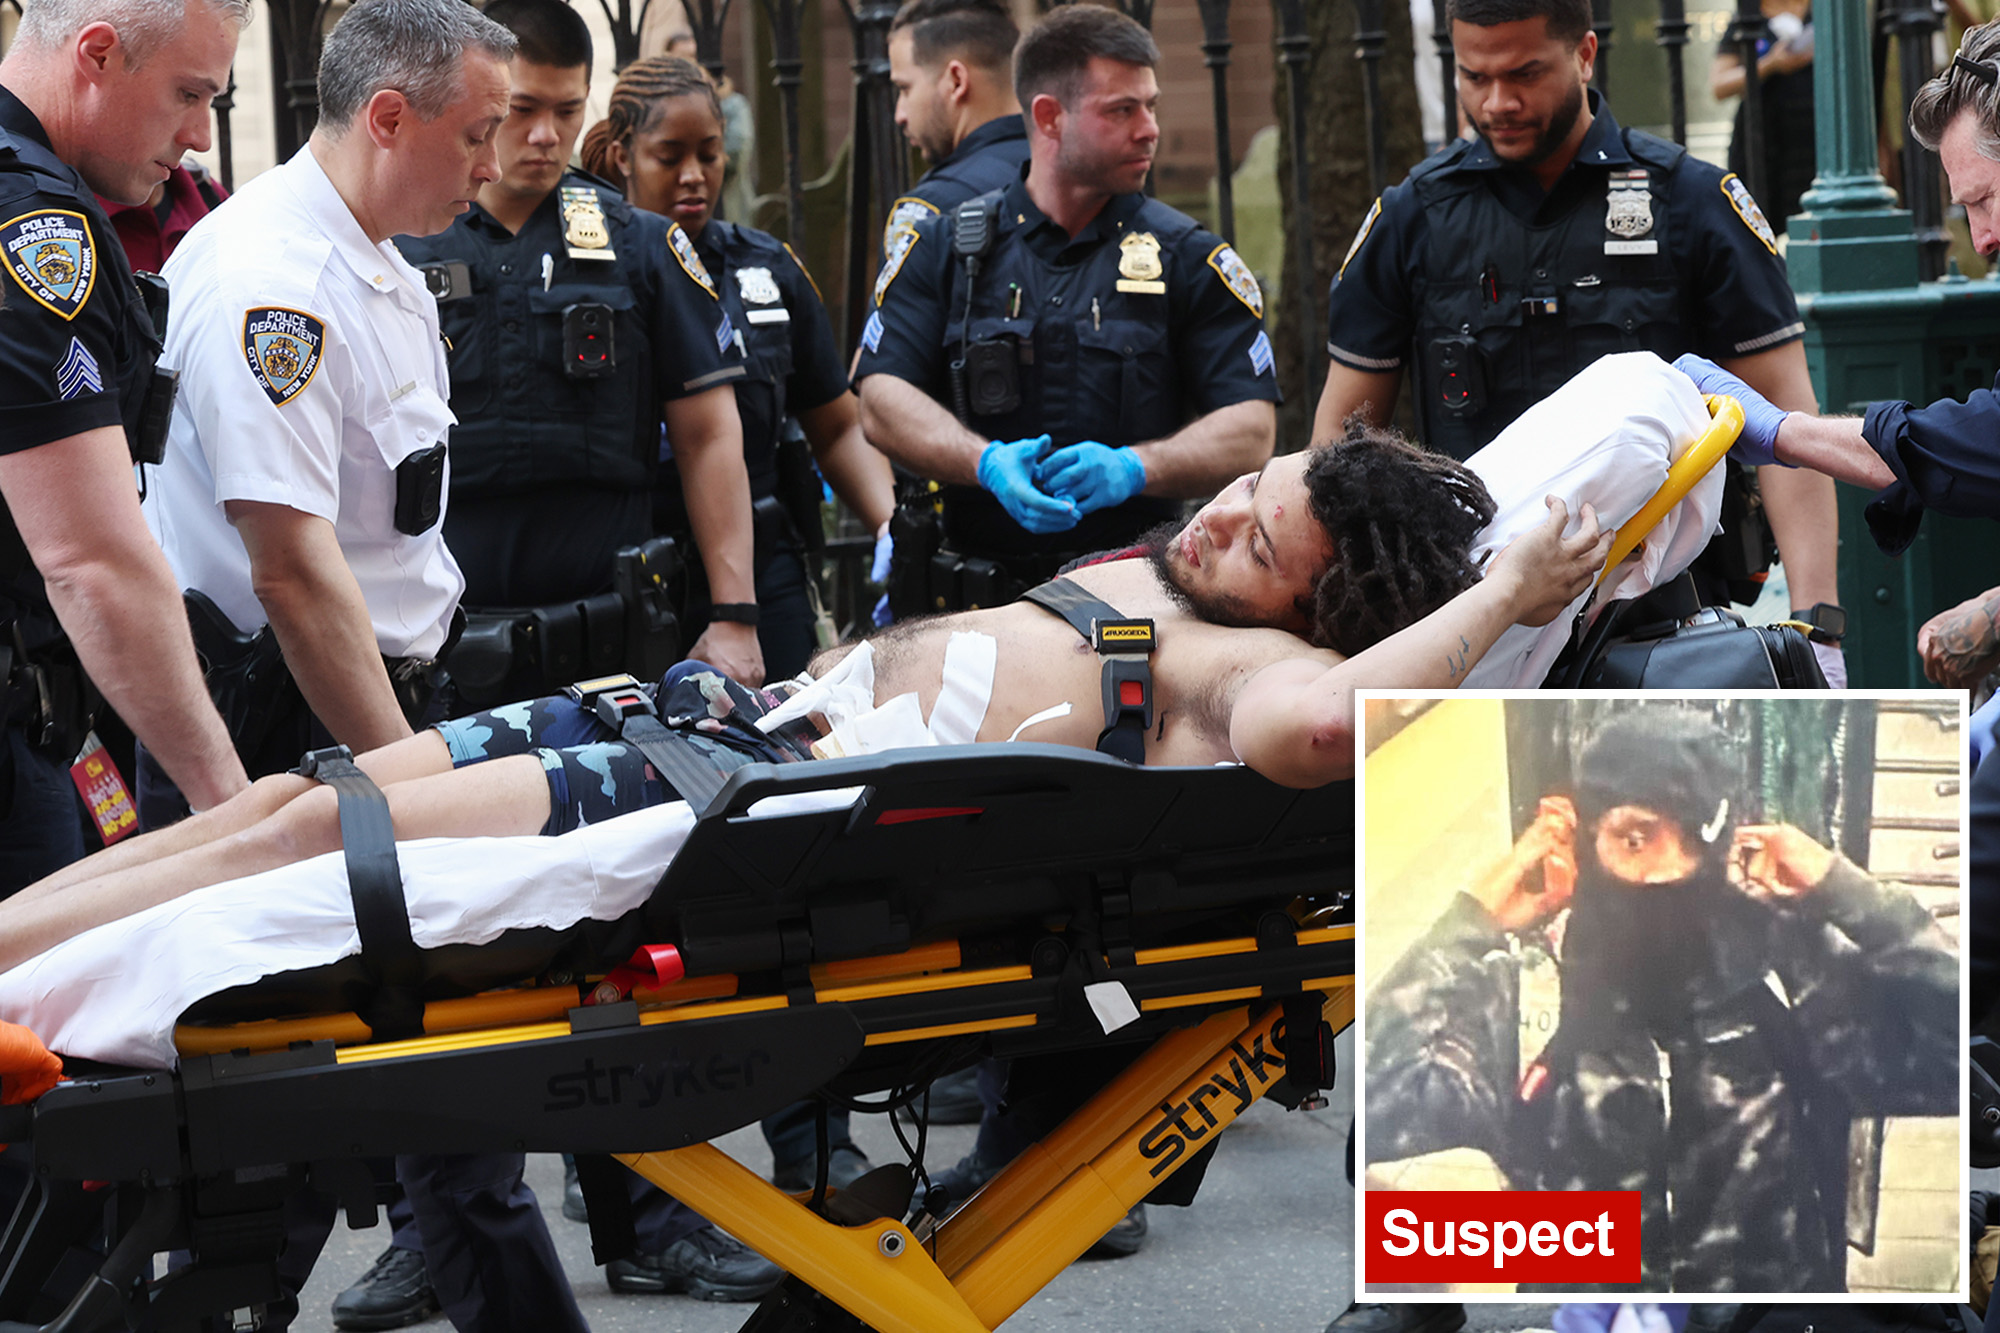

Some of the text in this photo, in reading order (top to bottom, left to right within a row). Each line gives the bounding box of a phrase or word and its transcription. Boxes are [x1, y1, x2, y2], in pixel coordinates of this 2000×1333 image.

[7, 229, 84, 253] DEPARTMENT
[19, 216, 66, 235] POLICE
[15, 263, 57, 302] CITY OF
[71, 247, 92, 303] NEW YORK
[249, 321, 319, 346] DEPARTMENT
[267, 311, 307, 328] POLICE
[247, 346, 270, 389] CITY OF
[282, 353, 318, 398] NEW YORK
[544, 1049, 770, 1112] stryker
